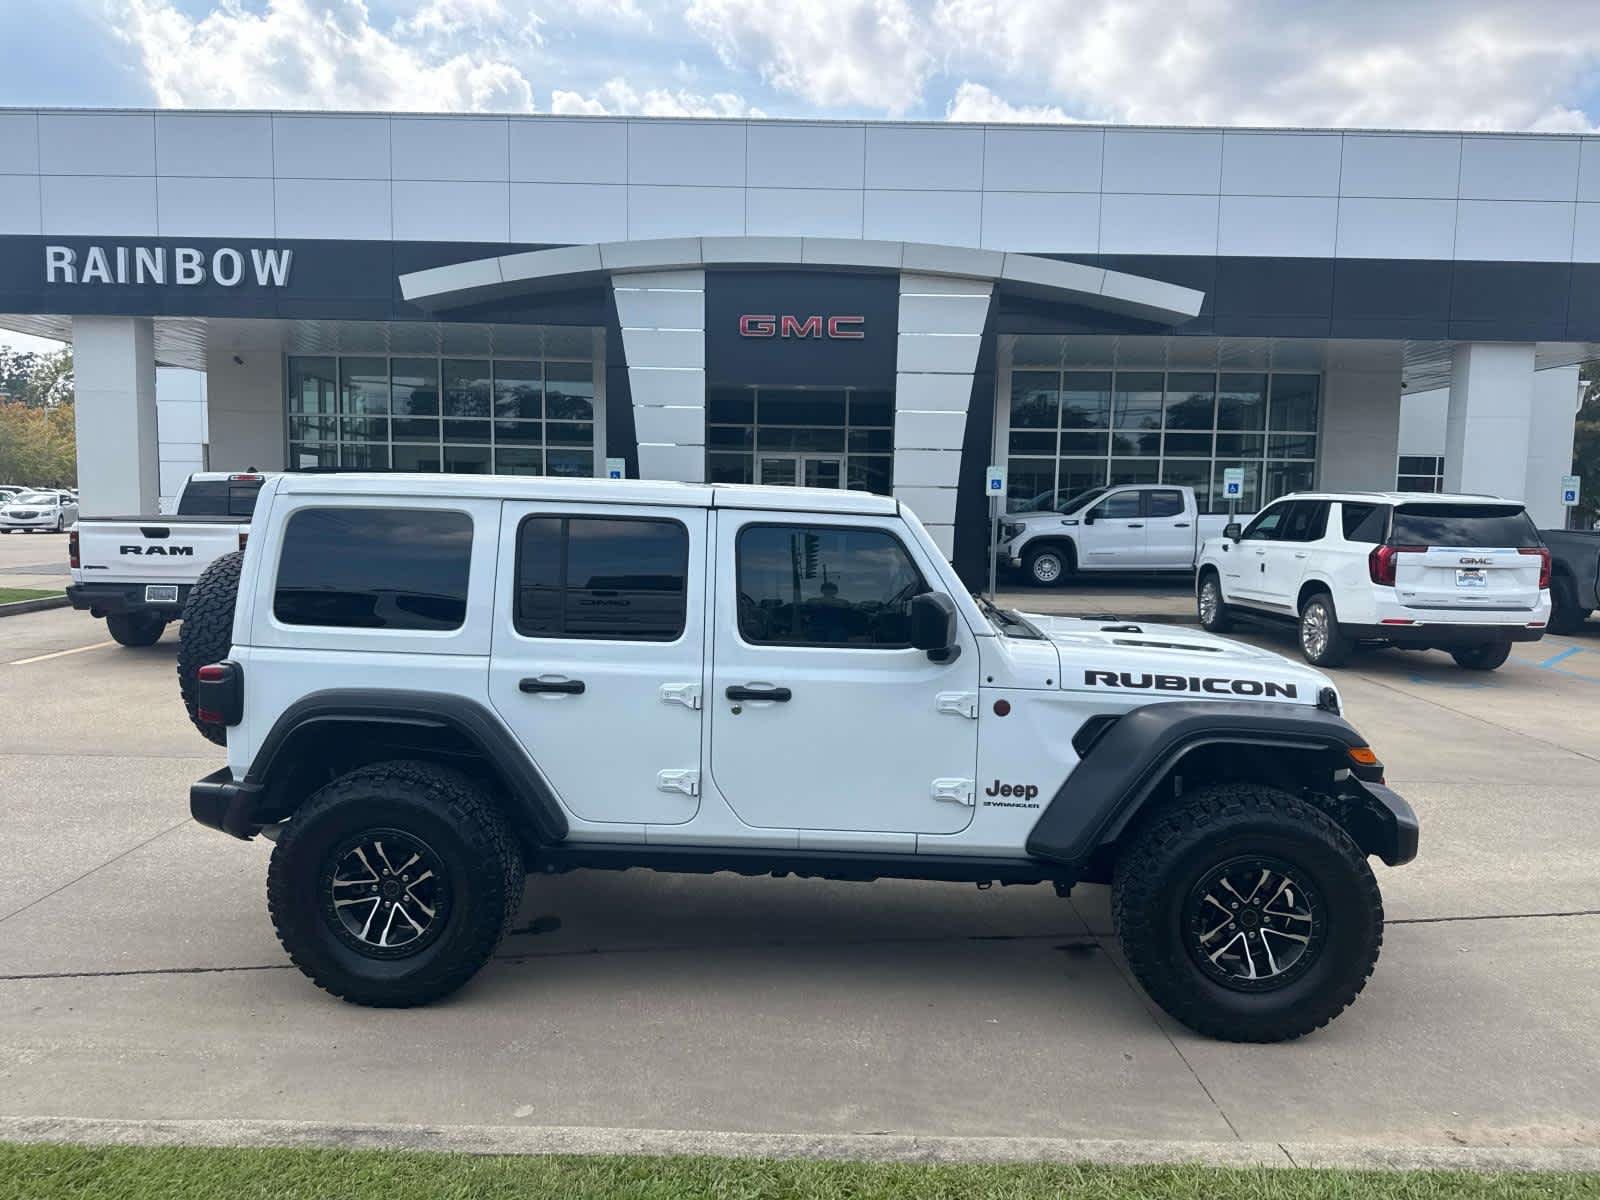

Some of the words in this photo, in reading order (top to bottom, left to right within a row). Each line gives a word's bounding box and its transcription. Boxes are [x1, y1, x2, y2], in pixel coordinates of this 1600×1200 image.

[46, 246, 292, 287] RAINBOW
[739, 314, 865, 338] GMC
[120, 545, 194, 556] RAM
[1459, 557, 1494, 565] GMC
[1084, 670, 1298, 698] RUBICON
[985, 779, 1039, 801] Jeep
[992, 801, 1040, 809] WRANGLER
